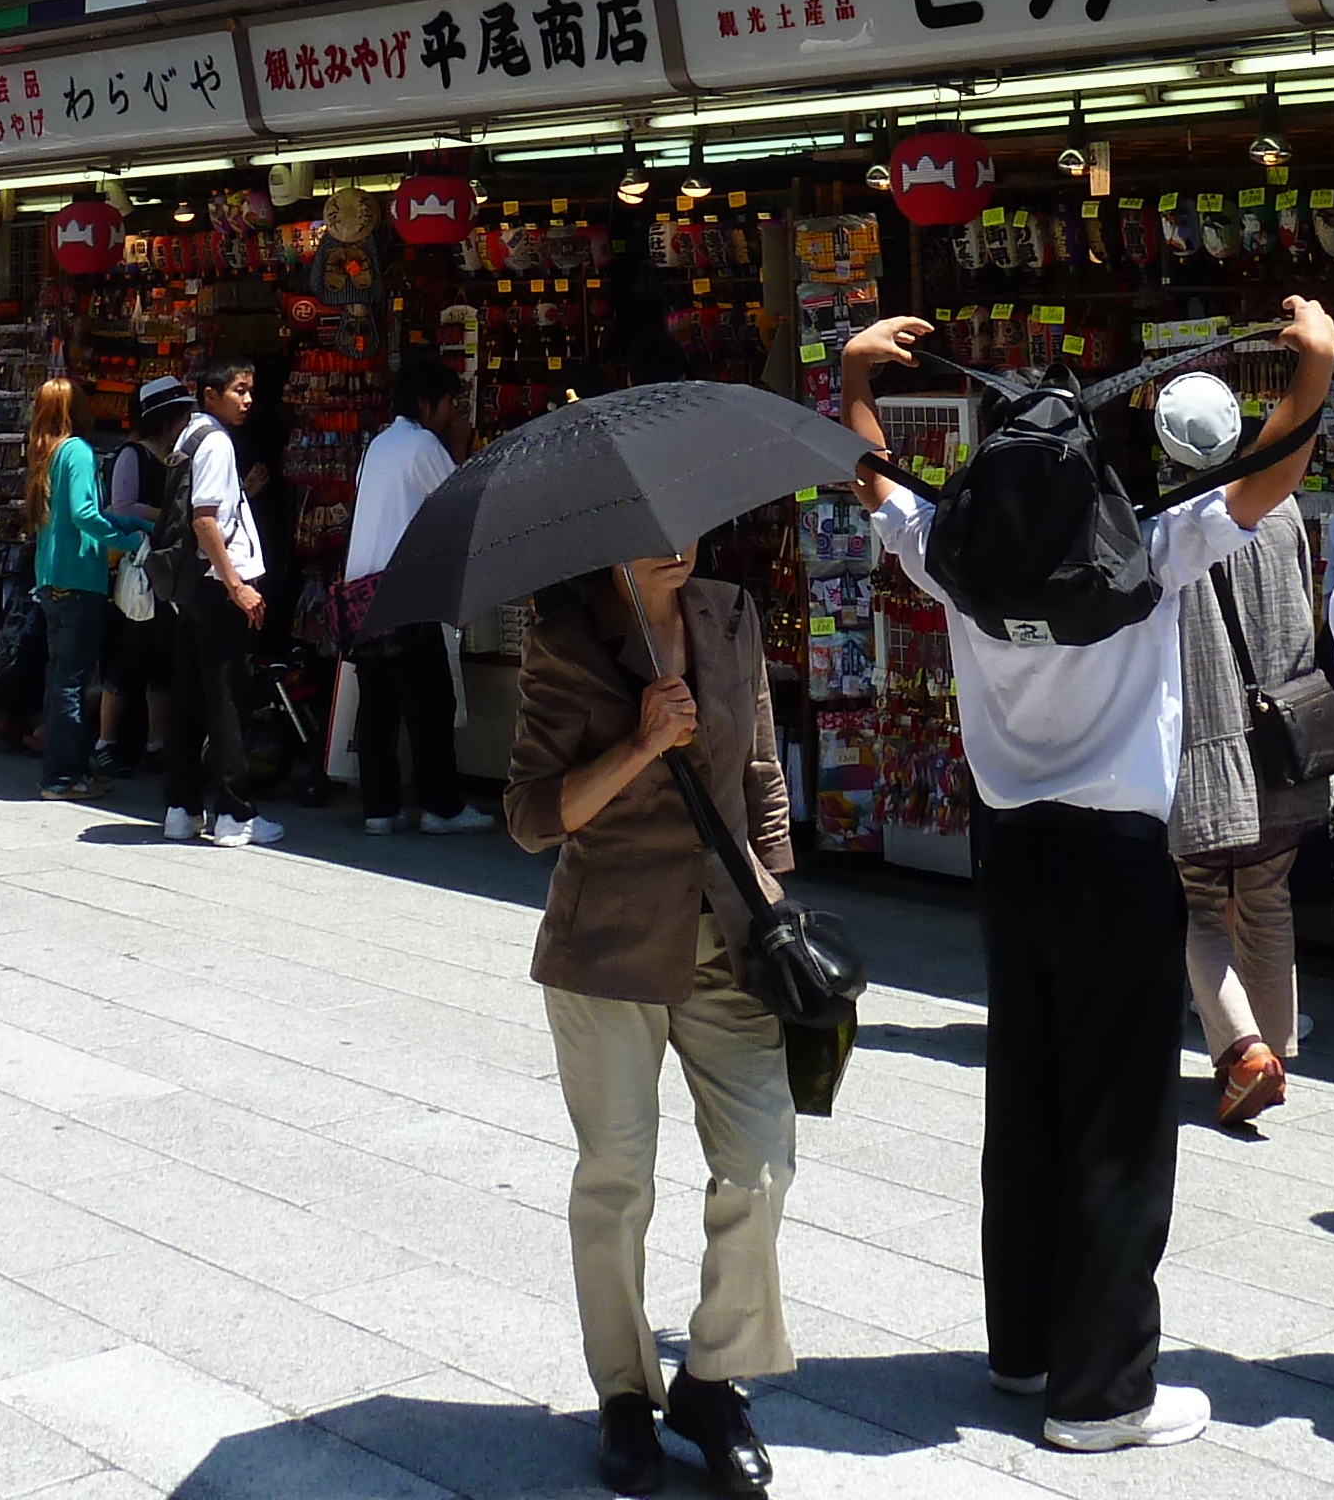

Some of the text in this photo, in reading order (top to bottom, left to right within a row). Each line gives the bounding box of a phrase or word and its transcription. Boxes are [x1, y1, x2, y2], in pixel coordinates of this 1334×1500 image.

[63, 54, 222, 122] わらびや
[264, 30, 412, 91] 観光みやげ
